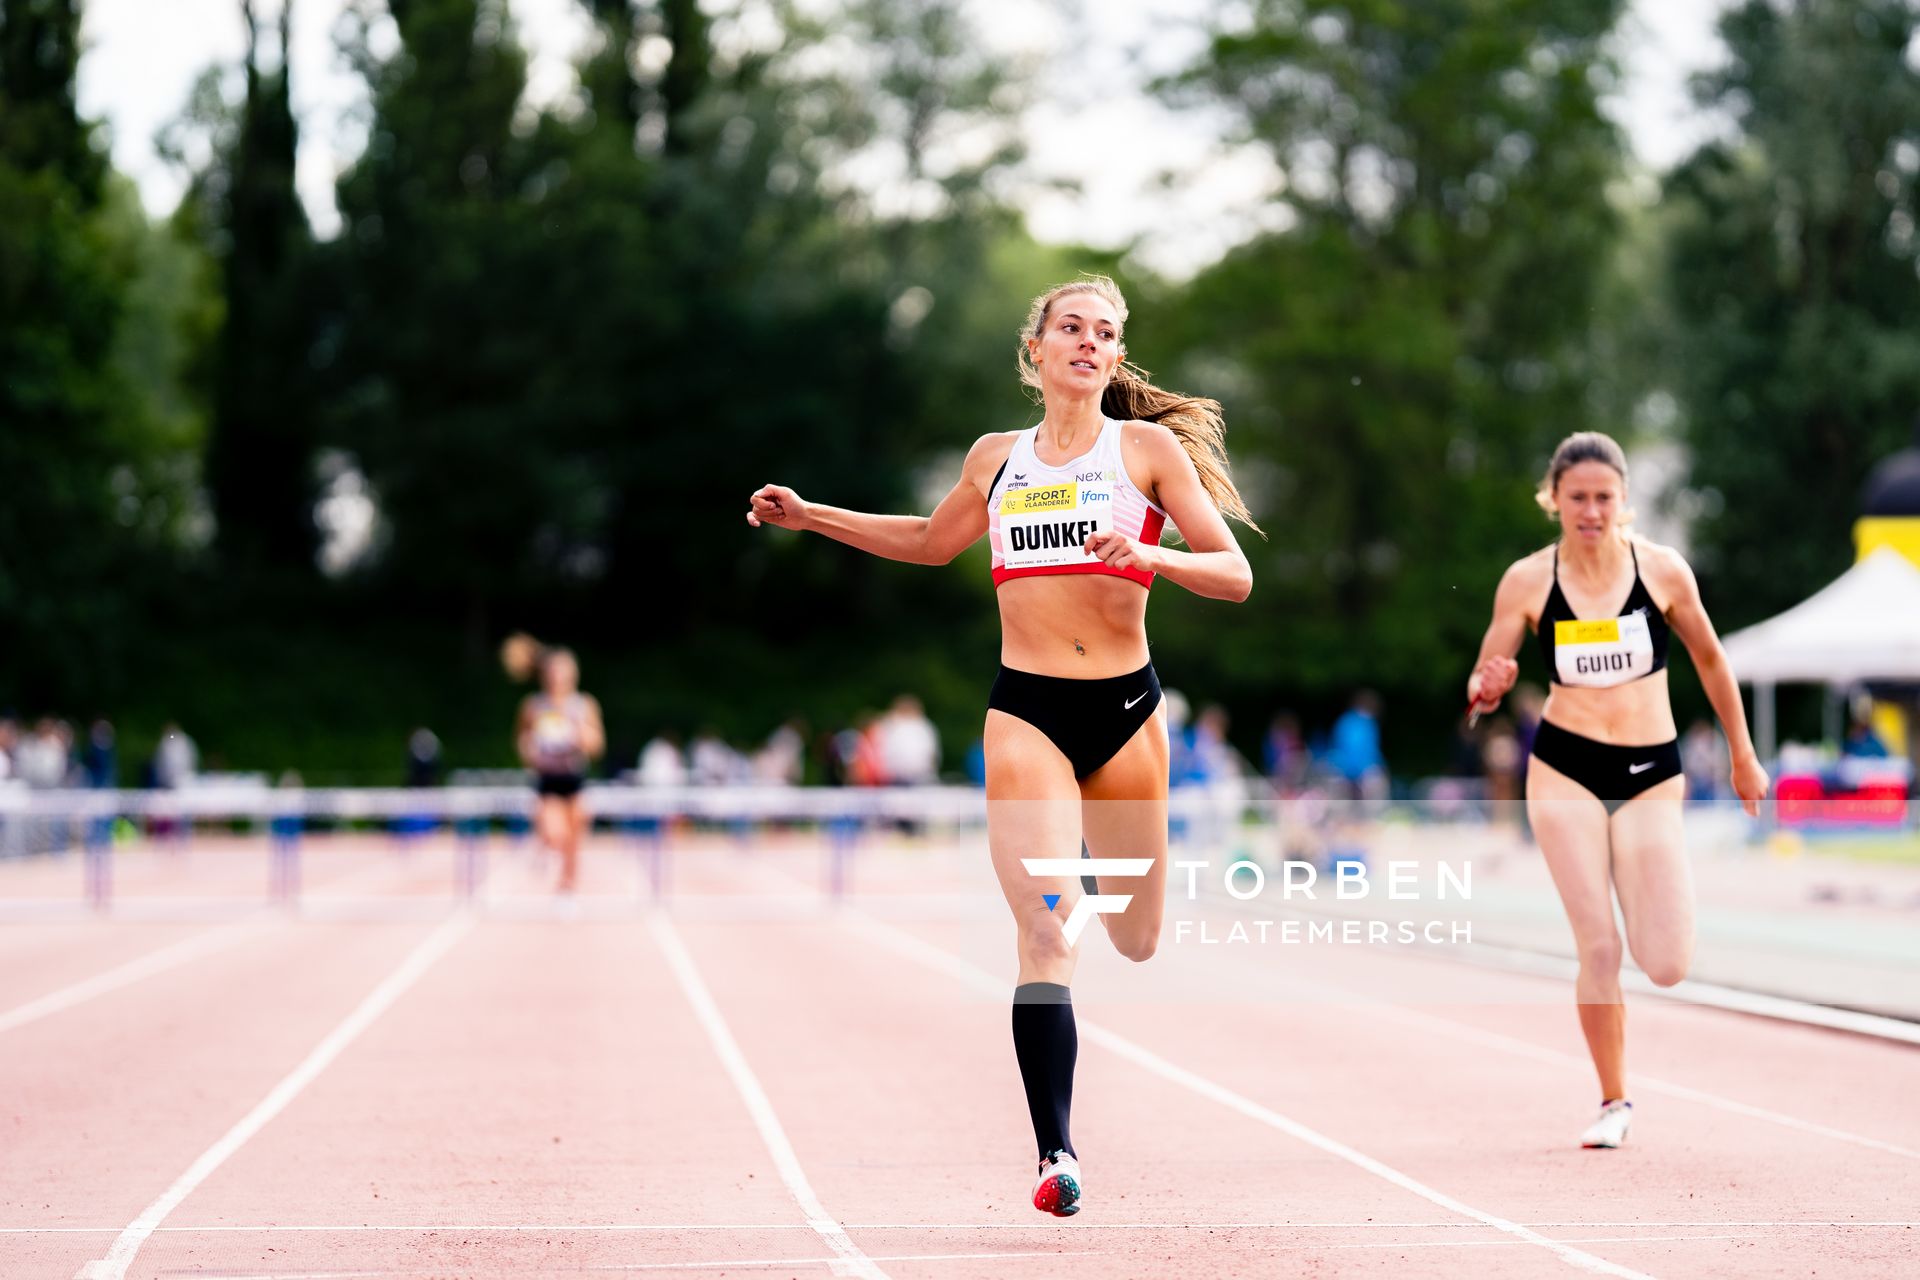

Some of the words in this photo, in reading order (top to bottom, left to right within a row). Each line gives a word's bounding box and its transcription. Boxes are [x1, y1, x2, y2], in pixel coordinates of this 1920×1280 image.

[1025, 489, 1071, 502] SPORT.
[1081, 490, 1110, 504] ifam
[1024, 499, 1070, 508] VLAANDEREN
[1576, 652, 1632, 673] GUIOT
